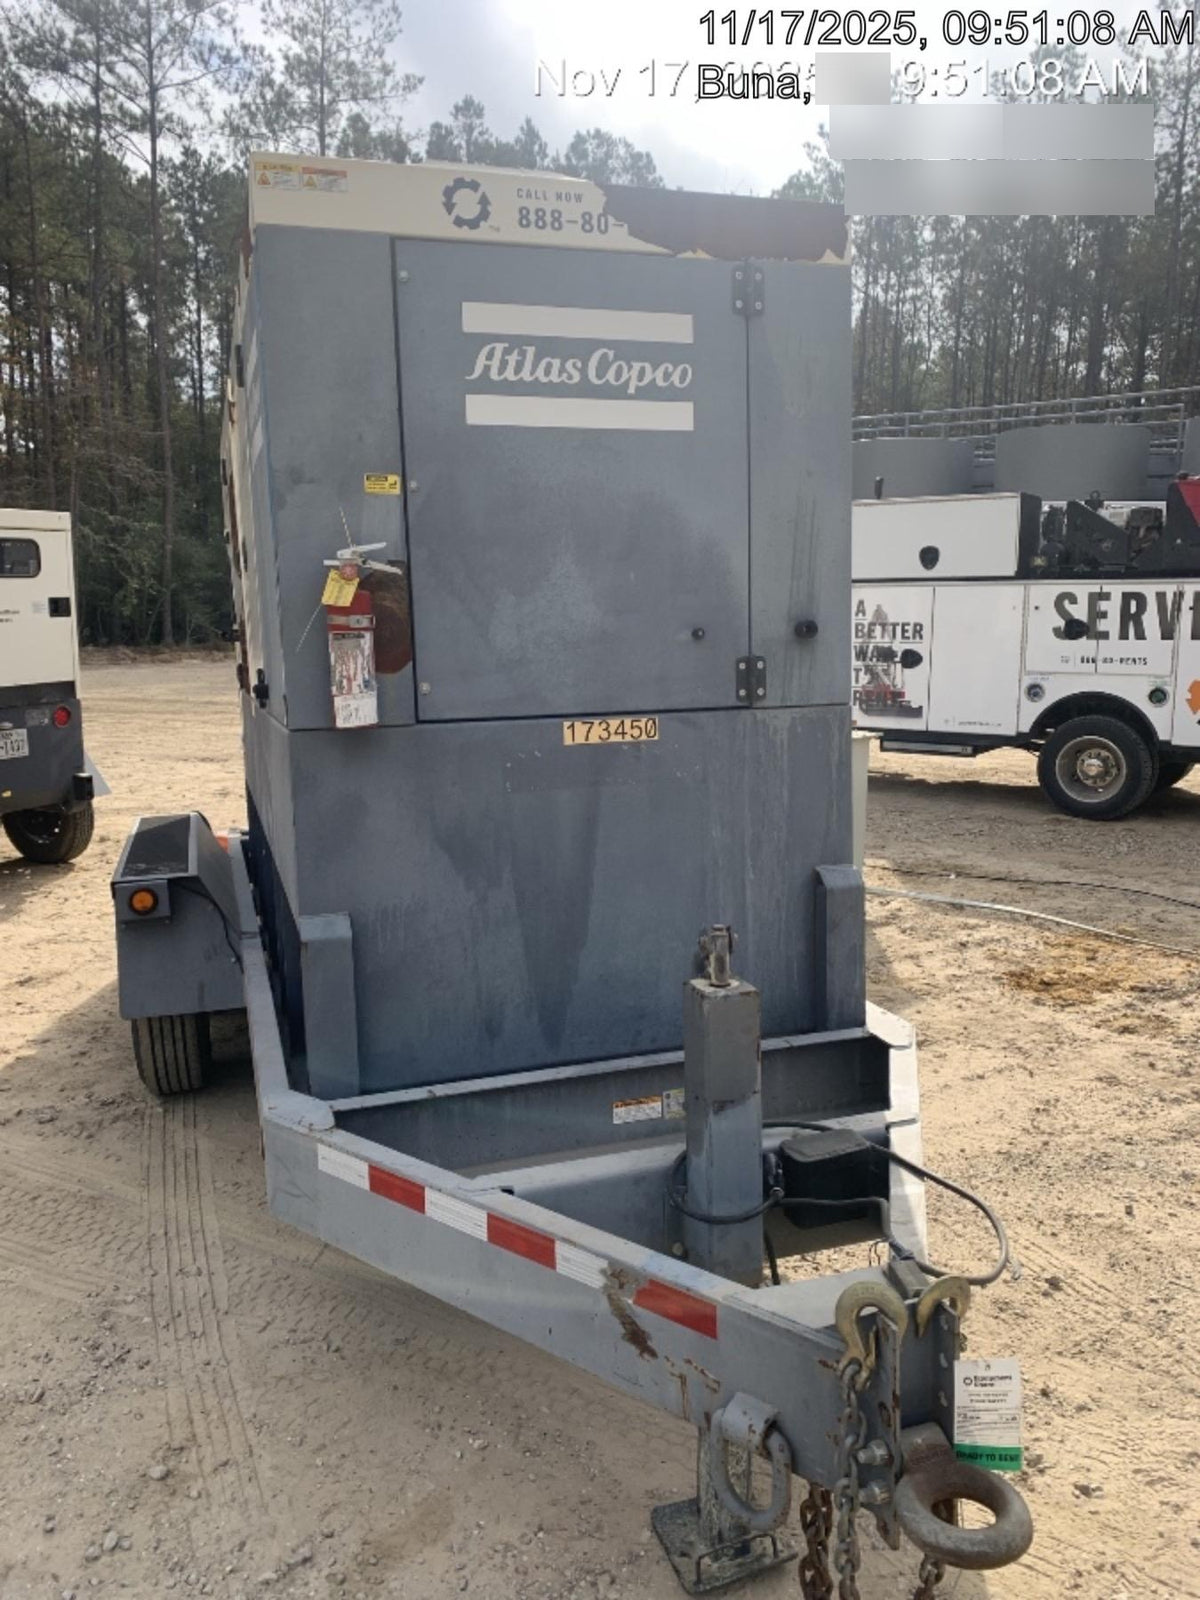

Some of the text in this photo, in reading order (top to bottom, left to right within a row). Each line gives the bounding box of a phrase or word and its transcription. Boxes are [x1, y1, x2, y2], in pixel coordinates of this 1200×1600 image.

[516, 187, 584, 204] CALL NOW
[465, 342, 693, 395] Atlas Copco
[854, 599, 867, 618] A
[854, 621, 924, 641] BETTER
[566, 717, 657, 743] 173450
